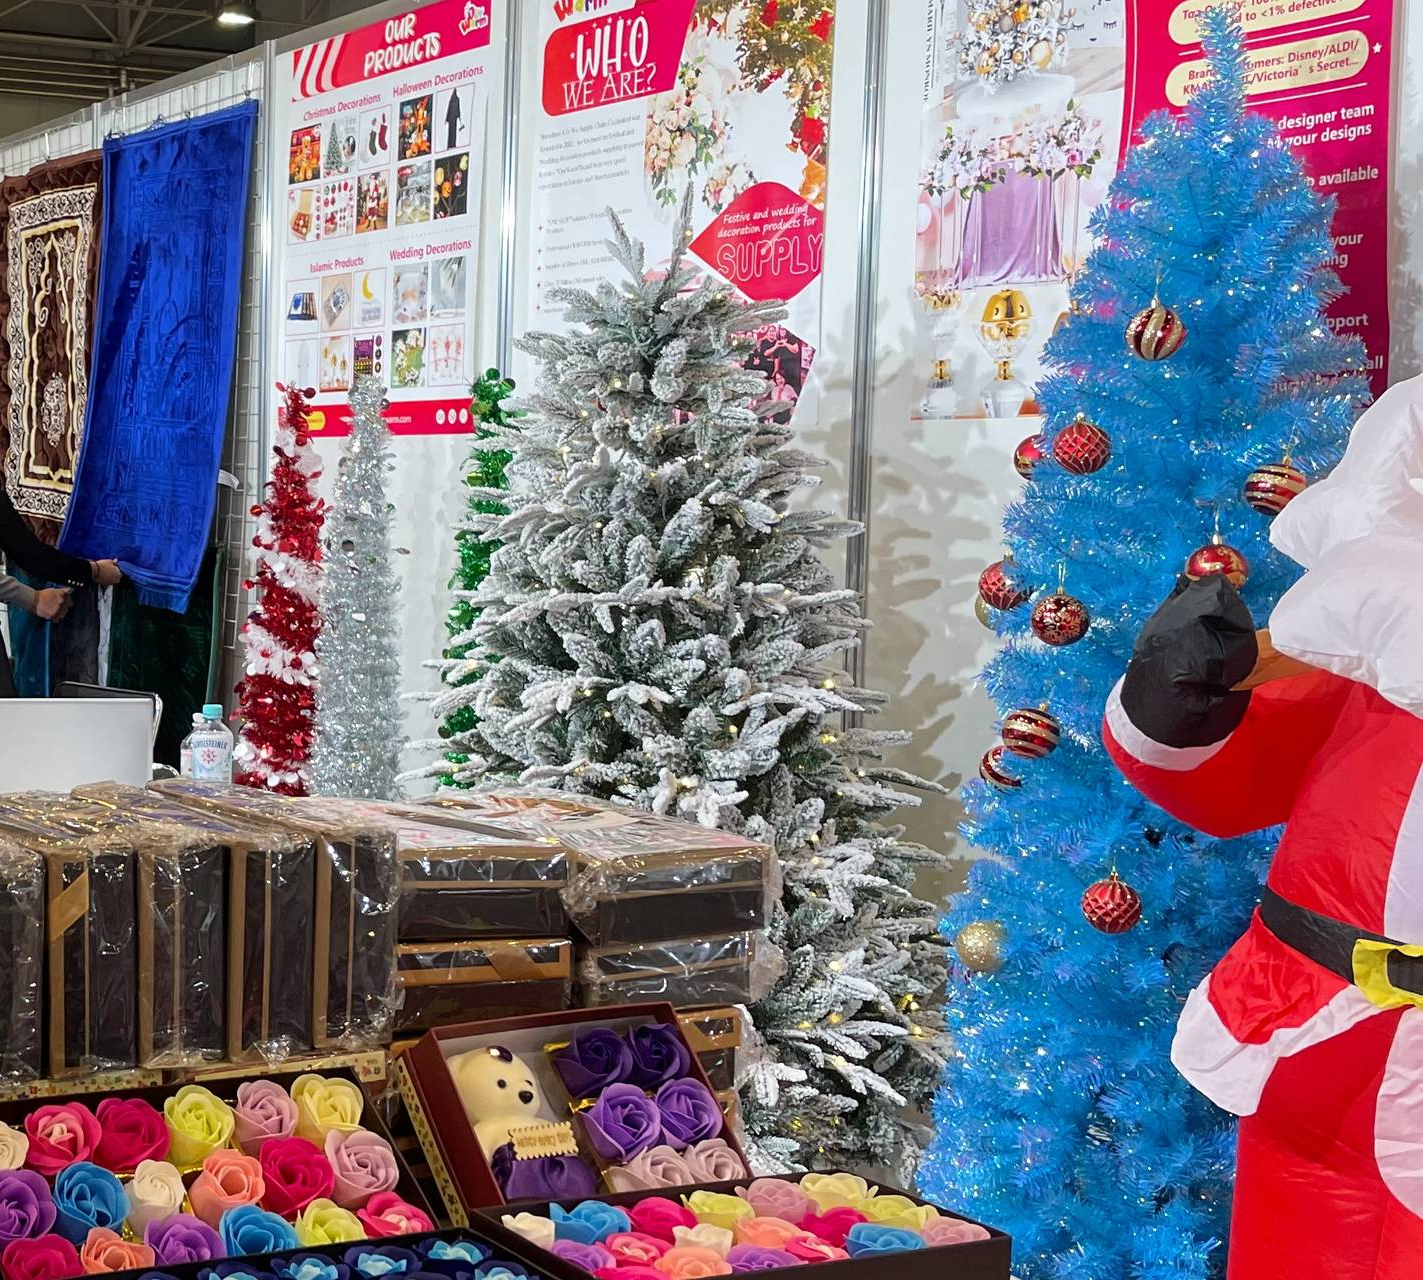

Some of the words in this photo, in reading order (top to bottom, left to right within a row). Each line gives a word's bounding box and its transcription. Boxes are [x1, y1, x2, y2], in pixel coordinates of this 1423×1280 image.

[1246, 11, 1256, 21] to
[1261, 3, 1285, 18] <1%
[385, 13, 416, 43] OUR
[363, 32, 441, 77] PRODUCTS
[576, 16, 648, 80] WHO
[1287, 39, 1359, 64] Disney/ALDI/
[1316, 57, 1359, 73] Secret...
[392, 80, 433, 97] Halloween
[434, 65, 484, 87] Decorations
[562, 80, 595, 110] WE
[600, 61, 656, 102] ARE?
[303, 102, 336, 121] Christmas
[338, 93, 382, 112] Decorations
[1278, 111, 1337, 130] designer
[1340, 104, 1375, 120] team
[1321, 123, 1372, 142] designs
[1319, 165, 1379, 186] available
[723, 211, 751, 225] Festive
[752, 207, 769, 220] and
[771, 204, 808, 218] wedding
[717, 224, 761, 239] decoration
[762, 218, 801, 236] products
[803, 216, 817, 227] for
[389, 246, 424, 261] Wedding
[426, 239, 472, 255] Decorations
[1331, 233, 1364, 247] your
[309, 261, 334, 273] Islamic
[334, 255, 364, 269] Products
[717, 233, 824, 281] SUPPLY
